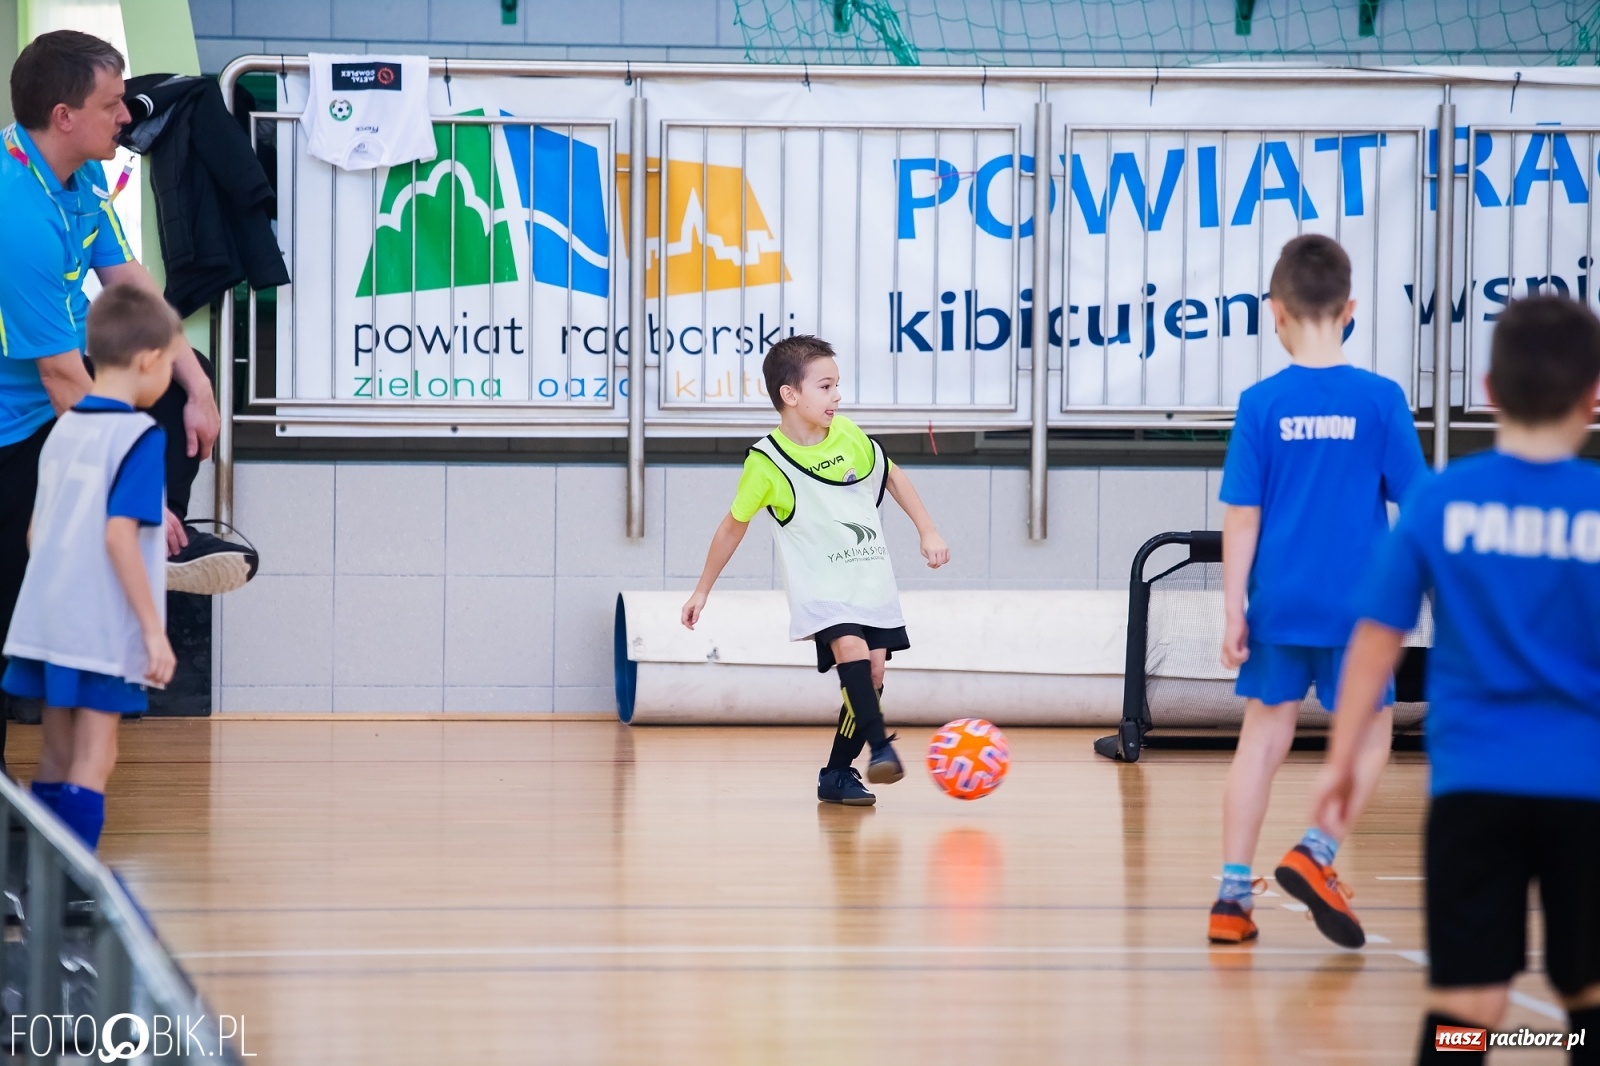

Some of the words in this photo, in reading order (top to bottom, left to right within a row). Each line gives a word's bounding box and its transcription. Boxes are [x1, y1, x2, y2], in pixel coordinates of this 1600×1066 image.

[340, 69, 376, 77] COMPLEX
[892, 134, 1387, 240] POWIAT
[1429, 122, 1600, 212] RA
[354, 311, 524, 367] powiat
[888, 283, 1356, 360] kibicujem
[353, 369, 502, 397] zielona
[1279, 415, 1357, 441] SZYMON
